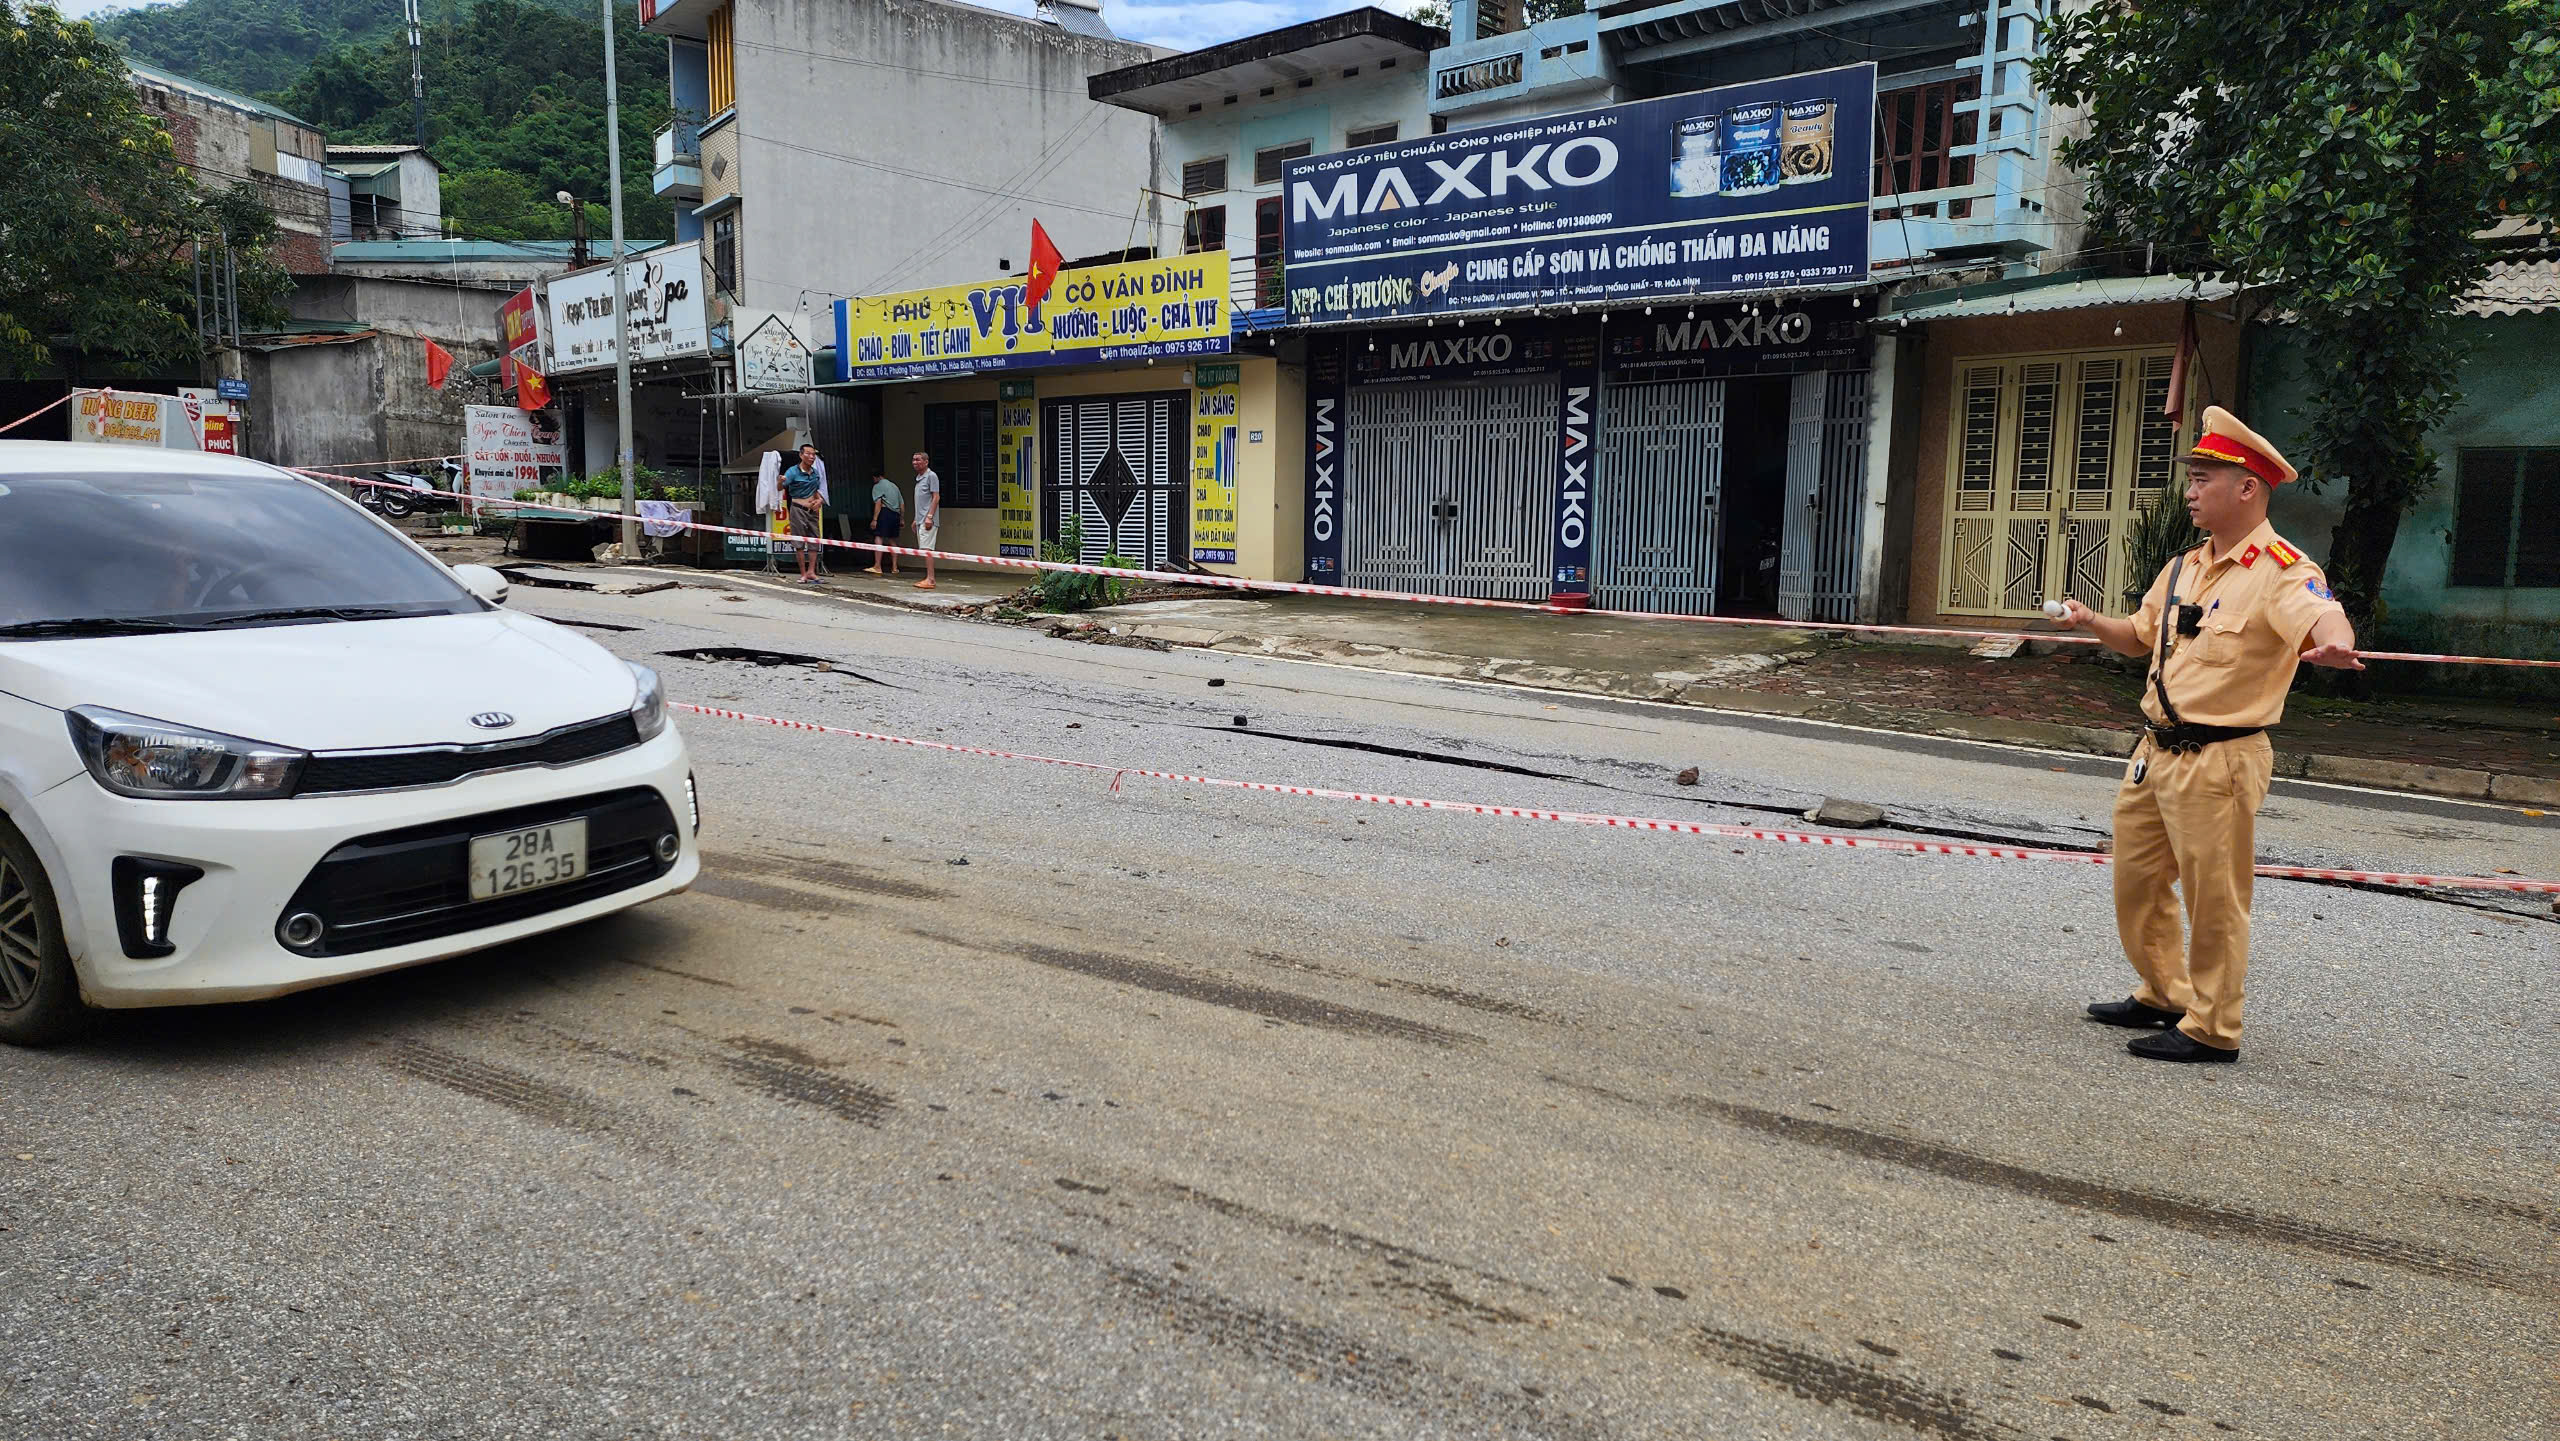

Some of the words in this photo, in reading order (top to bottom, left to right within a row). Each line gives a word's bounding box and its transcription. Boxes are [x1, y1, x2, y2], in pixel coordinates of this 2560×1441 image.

[1732, 108, 1772, 121] MAXKO
[1788, 103, 1825, 117] MAXKO
[1681, 120, 1714, 133] MAXKO
[1790, 122, 1823, 134] Beauty
[1292, 165, 1315, 175] SƠN
[1318, 160, 1343, 171] CAO
[1346, 153, 1372, 166] CẤP
[1374, 151, 1397, 162] TIÊU
[1401, 141, 1445, 158] CHUẨN
[1449, 135, 1490, 150] CÔNG
[1493, 127, 1543, 144] NGHIỆP
[1546, 121, 1584, 135] NHẬT
[1588, 115, 1618, 129] BẢN
[1292, 136, 1618, 224] MAXKO
[1327, 223, 1390, 237] Japanese
[1393, 217, 1428, 229] color
[1444, 206, 1514, 222] Japanese
[1519, 201, 1558, 213] style
[1294, 248, 1323, 259] Website:
[1325, 241, 1381, 255] sonmaxko.com
[1393, 236, 1417, 247] Email:
[1417, 225, 1510, 245] sonmaxko@gmail.com
[1521, 221, 1555, 233] Hotline:
[1557, 212, 1613, 229] 0913808099
[1466, 258, 1508, 282] CUNG
[1513, 247, 1545, 278] CẤP
[1550, 249, 1584, 275] SƠN
[1588, 244, 1610, 271] VÀ
[1615, 236, 1676, 269] CHỐNG
[1681, 228, 1734, 263] THẤM
[1739, 232, 1766, 257] ĐA
[1772, 224, 1829, 254] NĂNG
[1065, 275, 1096, 304] CỎ
[1102, 272, 1144, 300] VÂN
[1150, 266, 1204, 295] ĐÌNH
[1745, 272, 1764, 282] 0915
[1765, 270, 1780, 280] 925
[1780, 269, 1795, 279] 276
[1800, 267, 1820, 278] 0333
[1822, 266, 1837, 275] 720
[1838, 264, 1854, 274] 717
[1325, 276, 1349, 312] CHÍ
[1352, 274, 1413, 310] PHƯƠNG
[1053, 308, 1098, 340] NƯỚNG
[1112, 303, 1147, 340] LUỘC
[1161, 293, 1191, 331] CHẢ
[1195, 299, 1218, 332] VỊT
[858, 332, 883, 362] CHÁO
[892, 328, 912, 359] BÚN
[919, 322, 940, 357] TIẾT
[943, 327, 971, 354] CANH
[1656, 312, 1812, 352] MAXKO
[1165, 342, 1186, 355] 0975
[1187, 340, 1203, 352] 926
[1205, 338, 1221, 350] 172
[1390, 333, 1513, 369] MAXKO
[81, 395, 123, 419] HƯNG
[123, 400, 158, 422] BEER
[1199, 391, 1210, 416] ĂN
[1212, 390, 1235, 415] SÁNG
[1197, 422, 1212, 437] CHÁO
[1250, 432, 1262, 441] 820
[207, 437, 231, 450] PHÚC
[1197, 443, 1208, 459] BÚN
[514, 466, 539, 480] 199k
[1313, 398, 1335, 542] MAXKO
[1561, 386, 1591, 549] MAXKO
[727, 535, 749, 545] CHUẨN
[1206, 550, 1217, 560] 0975
[1217, 551, 1226, 561] 926
[1226, 551, 1234, 561] 172
[478, 712, 511, 727] KIA
[506, 829, 554, 861] 28A
[488, 853, 575, 894] 126.35
